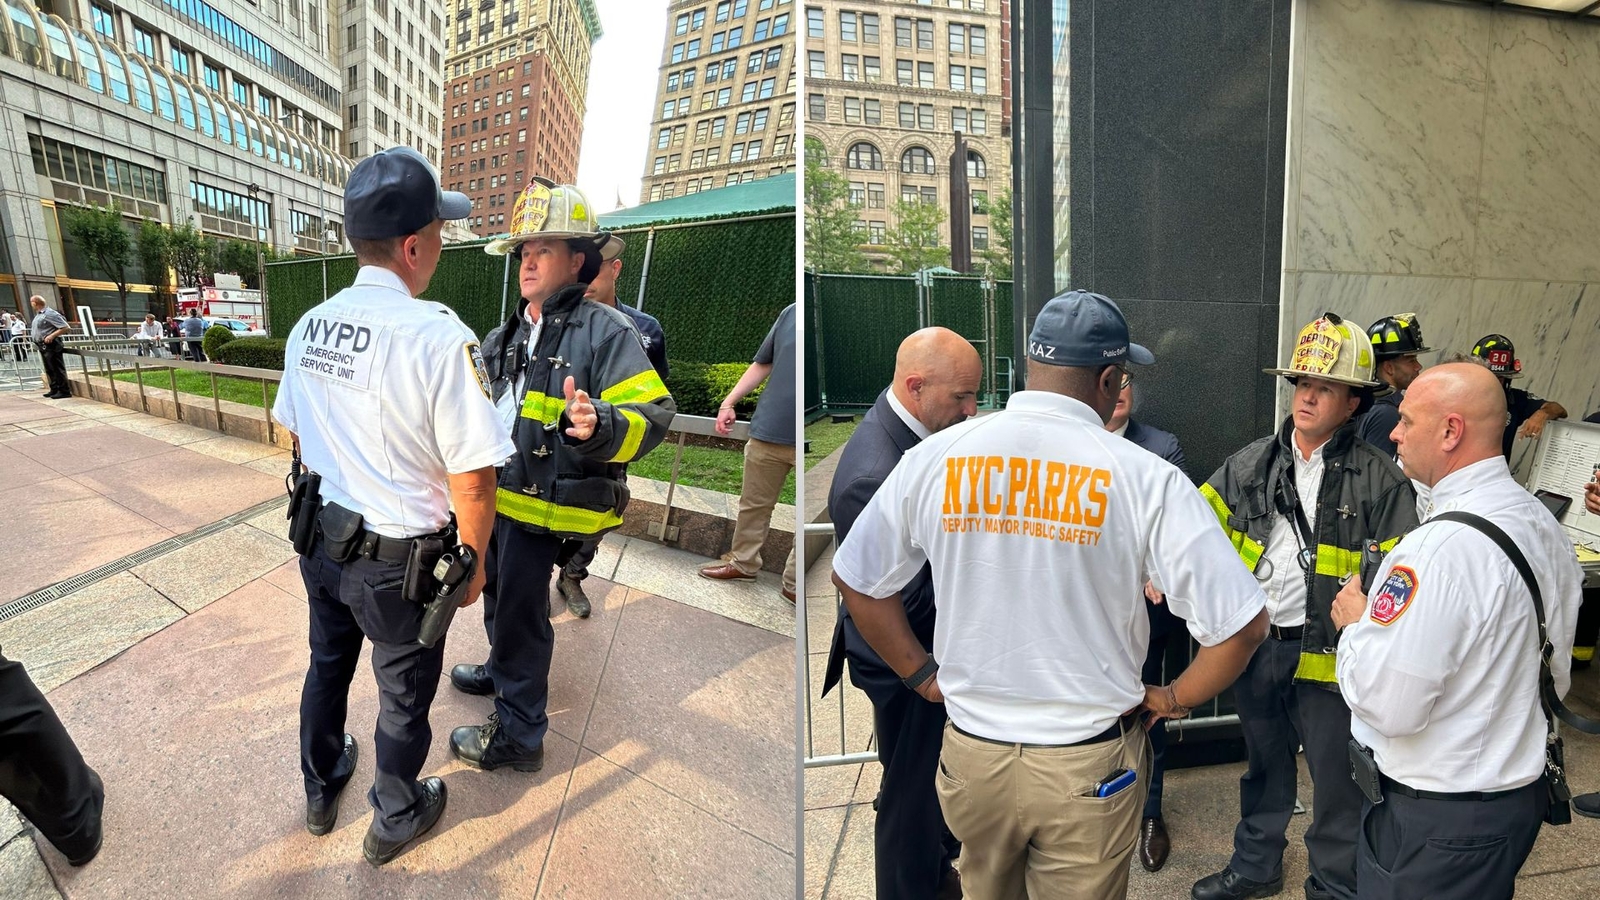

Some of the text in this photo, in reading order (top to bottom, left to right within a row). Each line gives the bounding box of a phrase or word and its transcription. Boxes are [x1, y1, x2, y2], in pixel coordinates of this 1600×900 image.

[302, 318, 371, 353] NYPD
[1300, 333, 1339, 351] DEPUTY
[305, 345, 355, 366] EMERGENCY
[1029, 340, 1056, 360] KAZ
[1102, 349, 1116, 357] Public
[1300, 347, 1332, 360] CHIEF
[1493, 353, 1507, 362] 20
[300, 357, 355, 380] SERVICE UNIT
[1295, 364, 1323, 374] FDNY
[942, 456, 1112, 527] NYC PARKS
[942, 518, 1102, 547] DEPUTY MAYOR PUBLIC SAFETY
